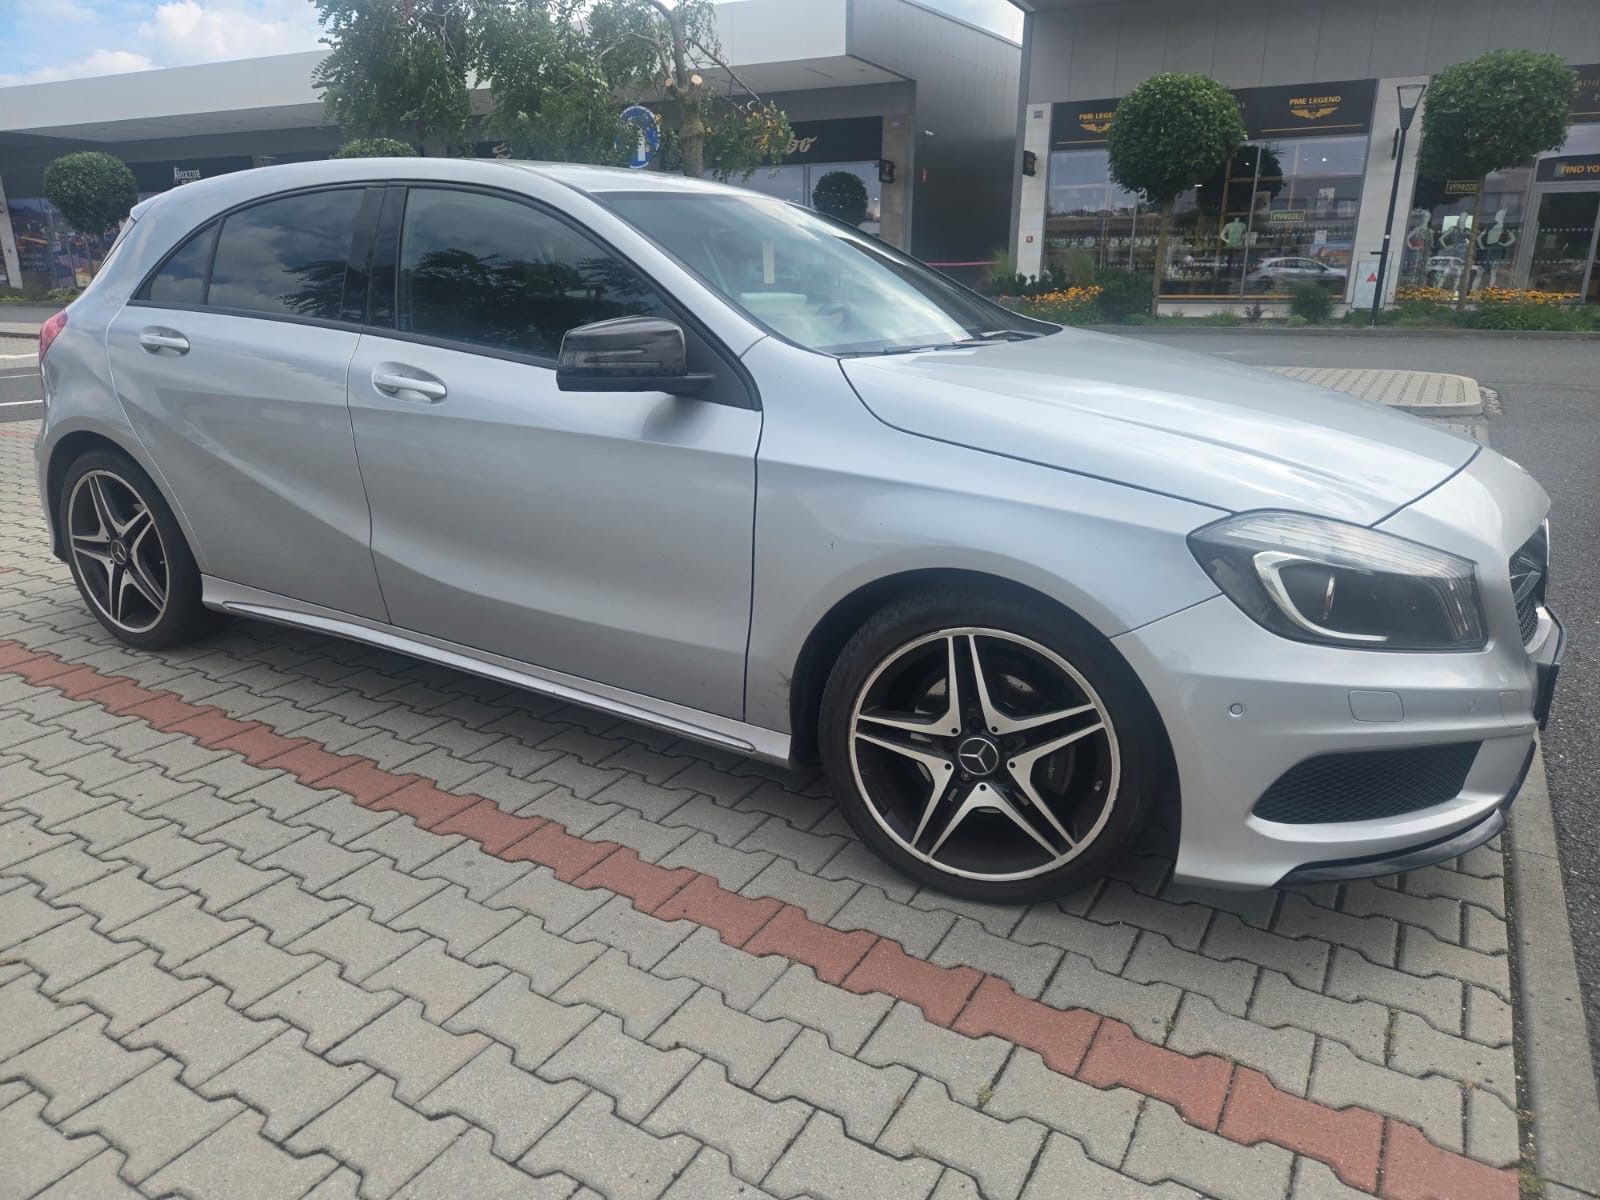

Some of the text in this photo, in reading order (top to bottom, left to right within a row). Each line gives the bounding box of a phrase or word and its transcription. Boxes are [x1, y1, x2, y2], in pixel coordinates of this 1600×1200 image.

[1289, 95, 1342, 105] PME LEGEND
[1095, 112, 1113, 120] LEGE
[1561, 165, 1585, 175] FIND
